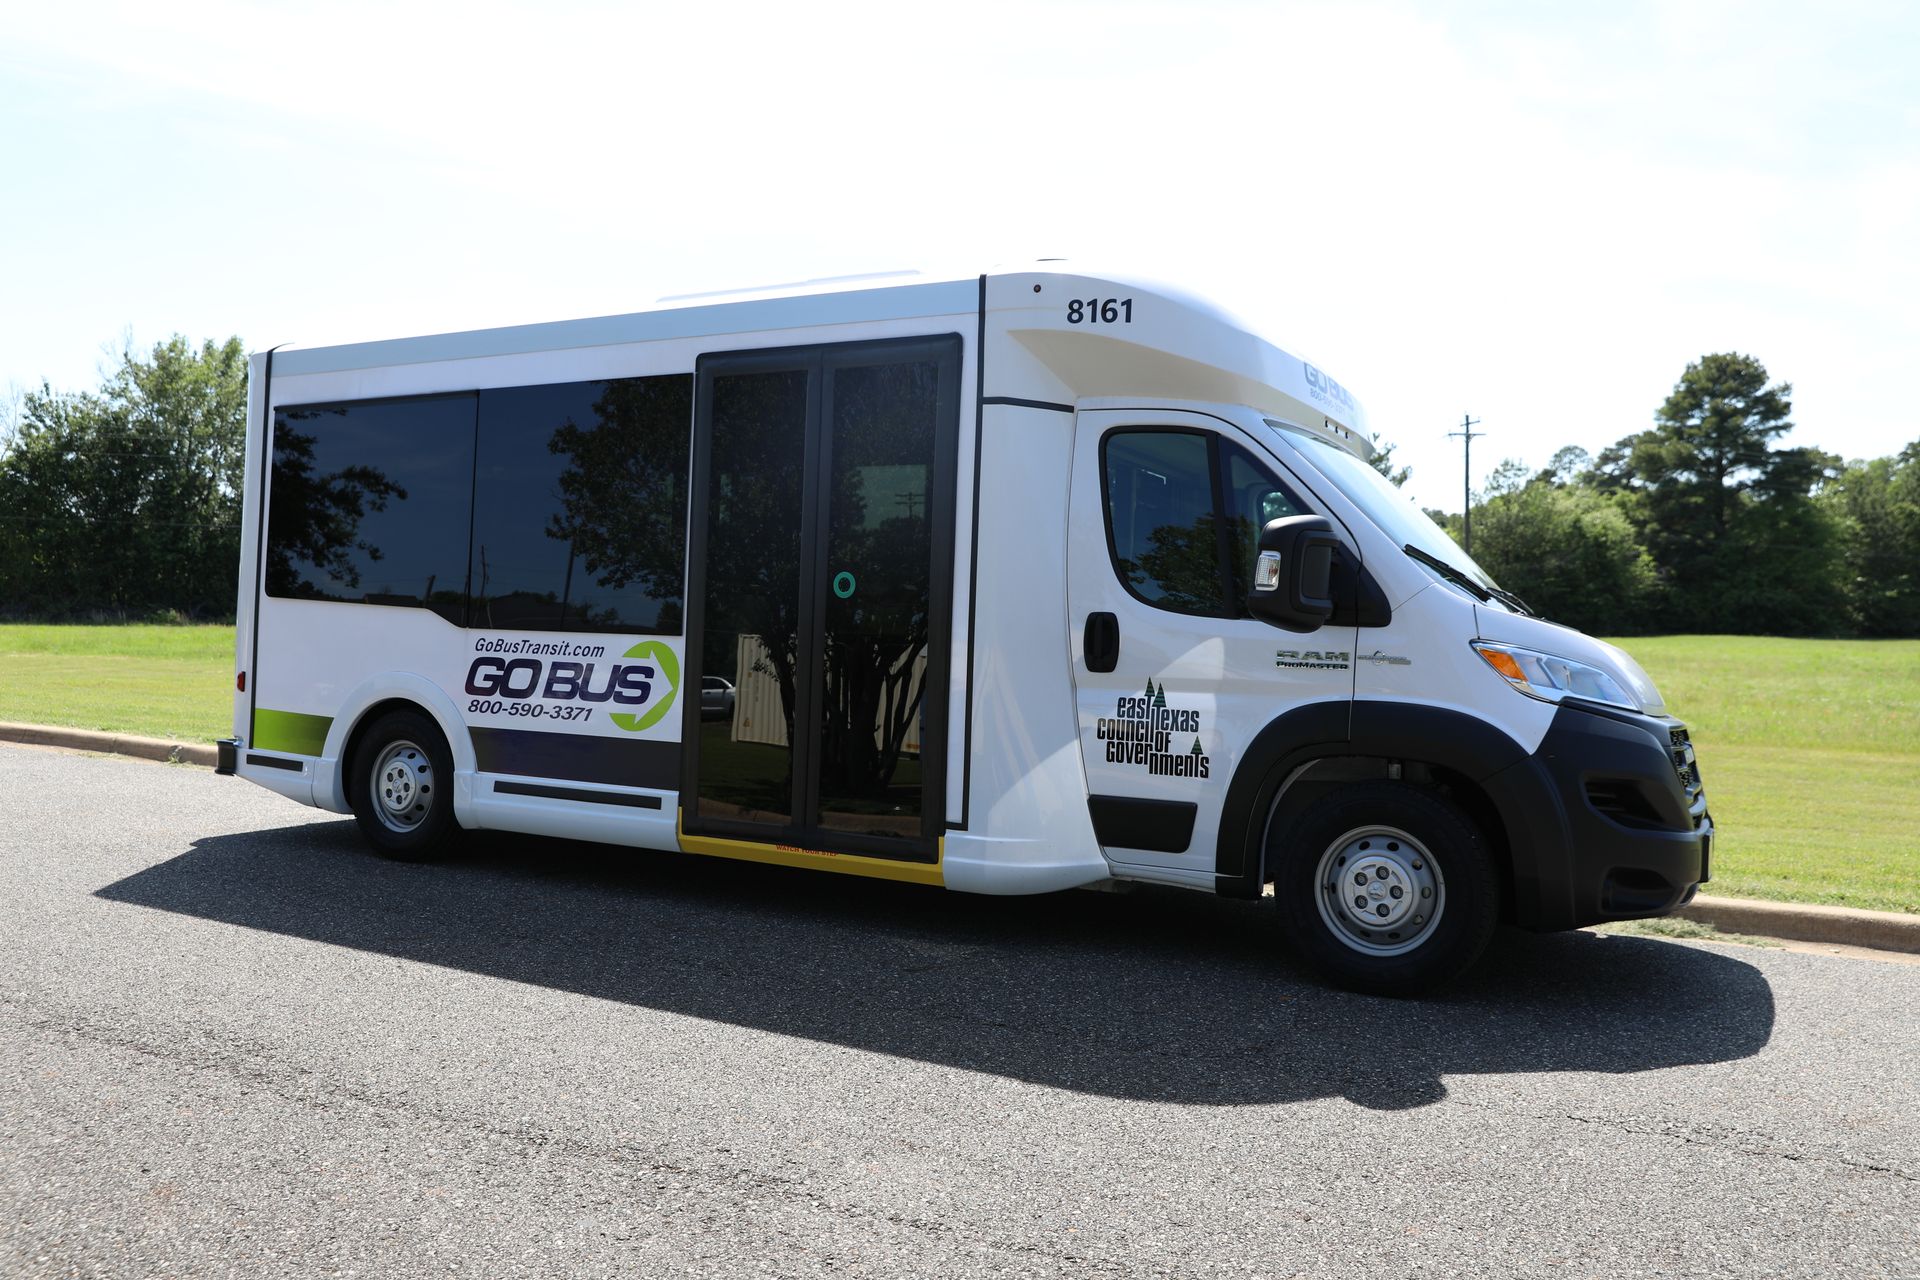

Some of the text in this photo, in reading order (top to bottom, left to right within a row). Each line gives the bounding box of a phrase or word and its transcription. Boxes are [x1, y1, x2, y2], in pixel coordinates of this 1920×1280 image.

[1066, 298, 1132, 324] 8161
[474, 637, 605, 658] GoBusTransit.com
[1276, 650, 1349, 662] RAM
[464, 656, 655, 705] GO BUS
[467, 699, 593, 722] 800-590-3371
